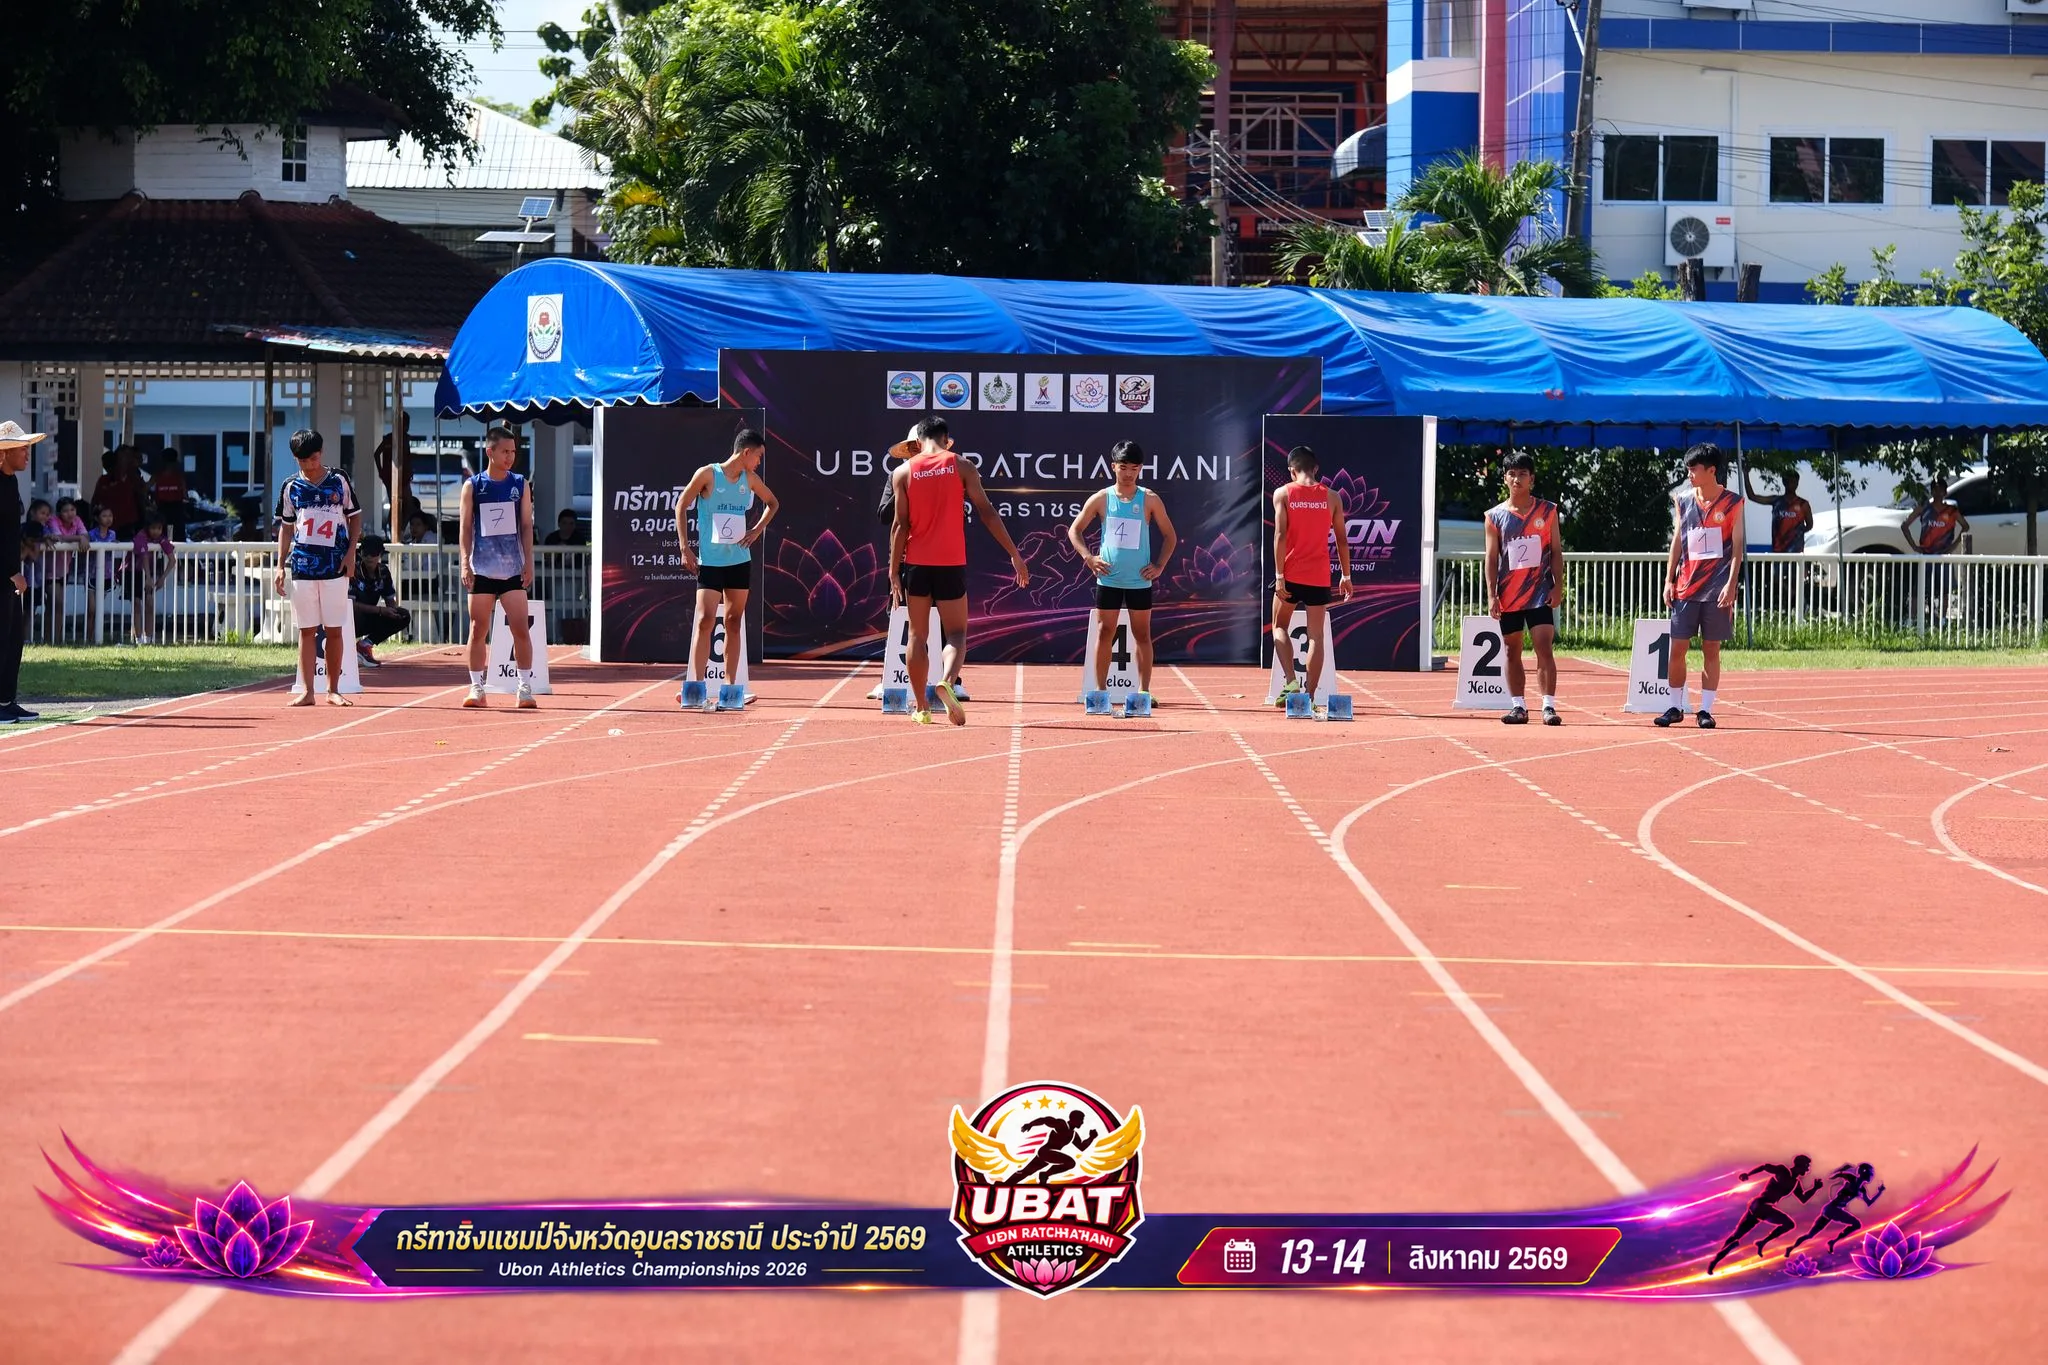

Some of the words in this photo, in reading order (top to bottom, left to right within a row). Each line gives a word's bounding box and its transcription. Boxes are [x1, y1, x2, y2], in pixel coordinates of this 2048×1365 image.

[962, 452, 1231, 480] RATCHAHANI
[303, 518, 333, 539] 14
[489, 508, 505, 528] 7
[721, 517, 733, 538] 6
[1115, 522, 1128, 542] 4
[1517, 545, 1529, 562] 2
[1697, 533, 1715, 554] 1
[1111, 624, 1132, 671] 4
[1472, 631, 1502, 677] 2
[1648, 633, 1670, 680] 1
[1106, 675, 1132, 688] elco
[1467, 680, 1503, 695] Nelco
